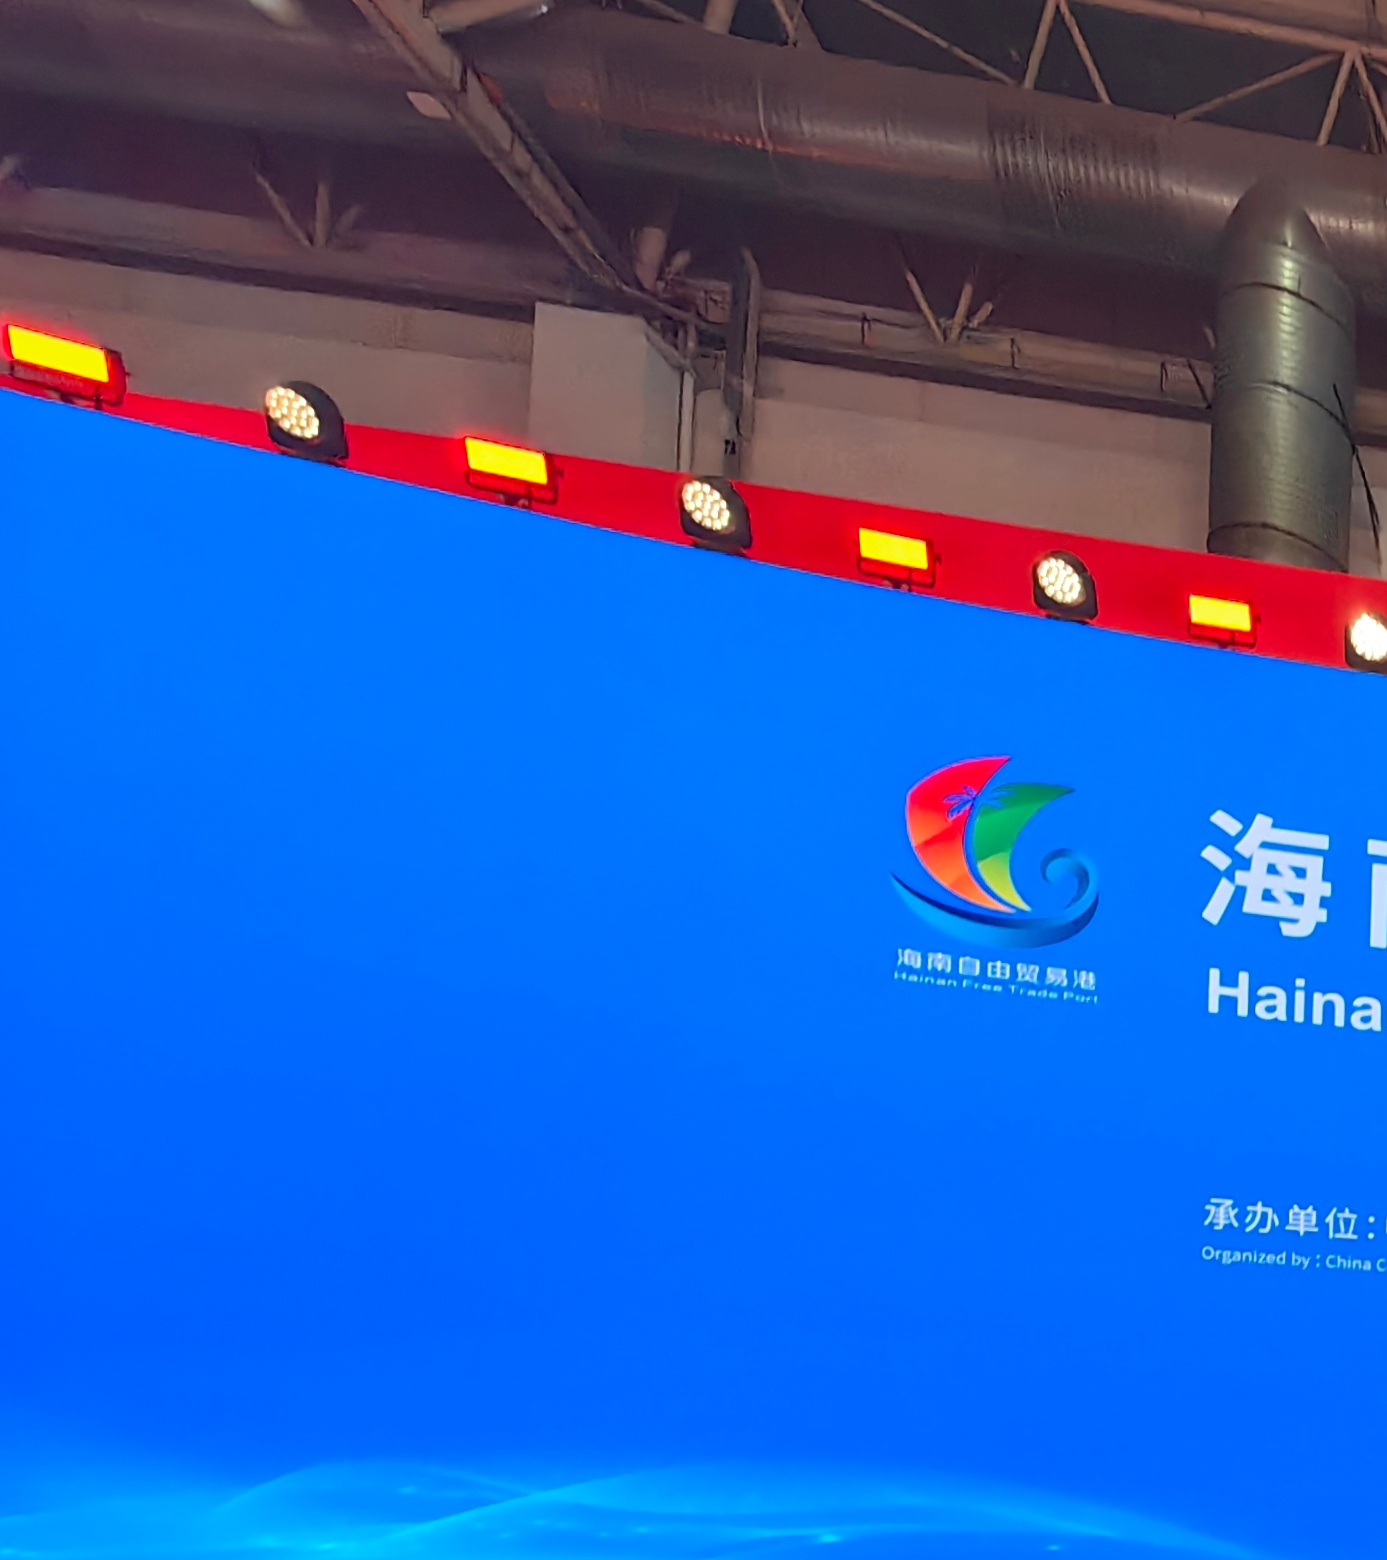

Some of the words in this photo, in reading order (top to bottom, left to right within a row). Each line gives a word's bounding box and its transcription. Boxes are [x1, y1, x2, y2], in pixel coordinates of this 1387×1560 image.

[897, 948, 1096, 990] 海南自由贸易港
[894, 971, 957, 988] Hainan
[962, 979, 1003, 993] Free
[1009, 984, 1058, 1000] Trade
[1202, 1245, 1286, 1266] Organized
[1326, 1254, 1372, 1271] China
